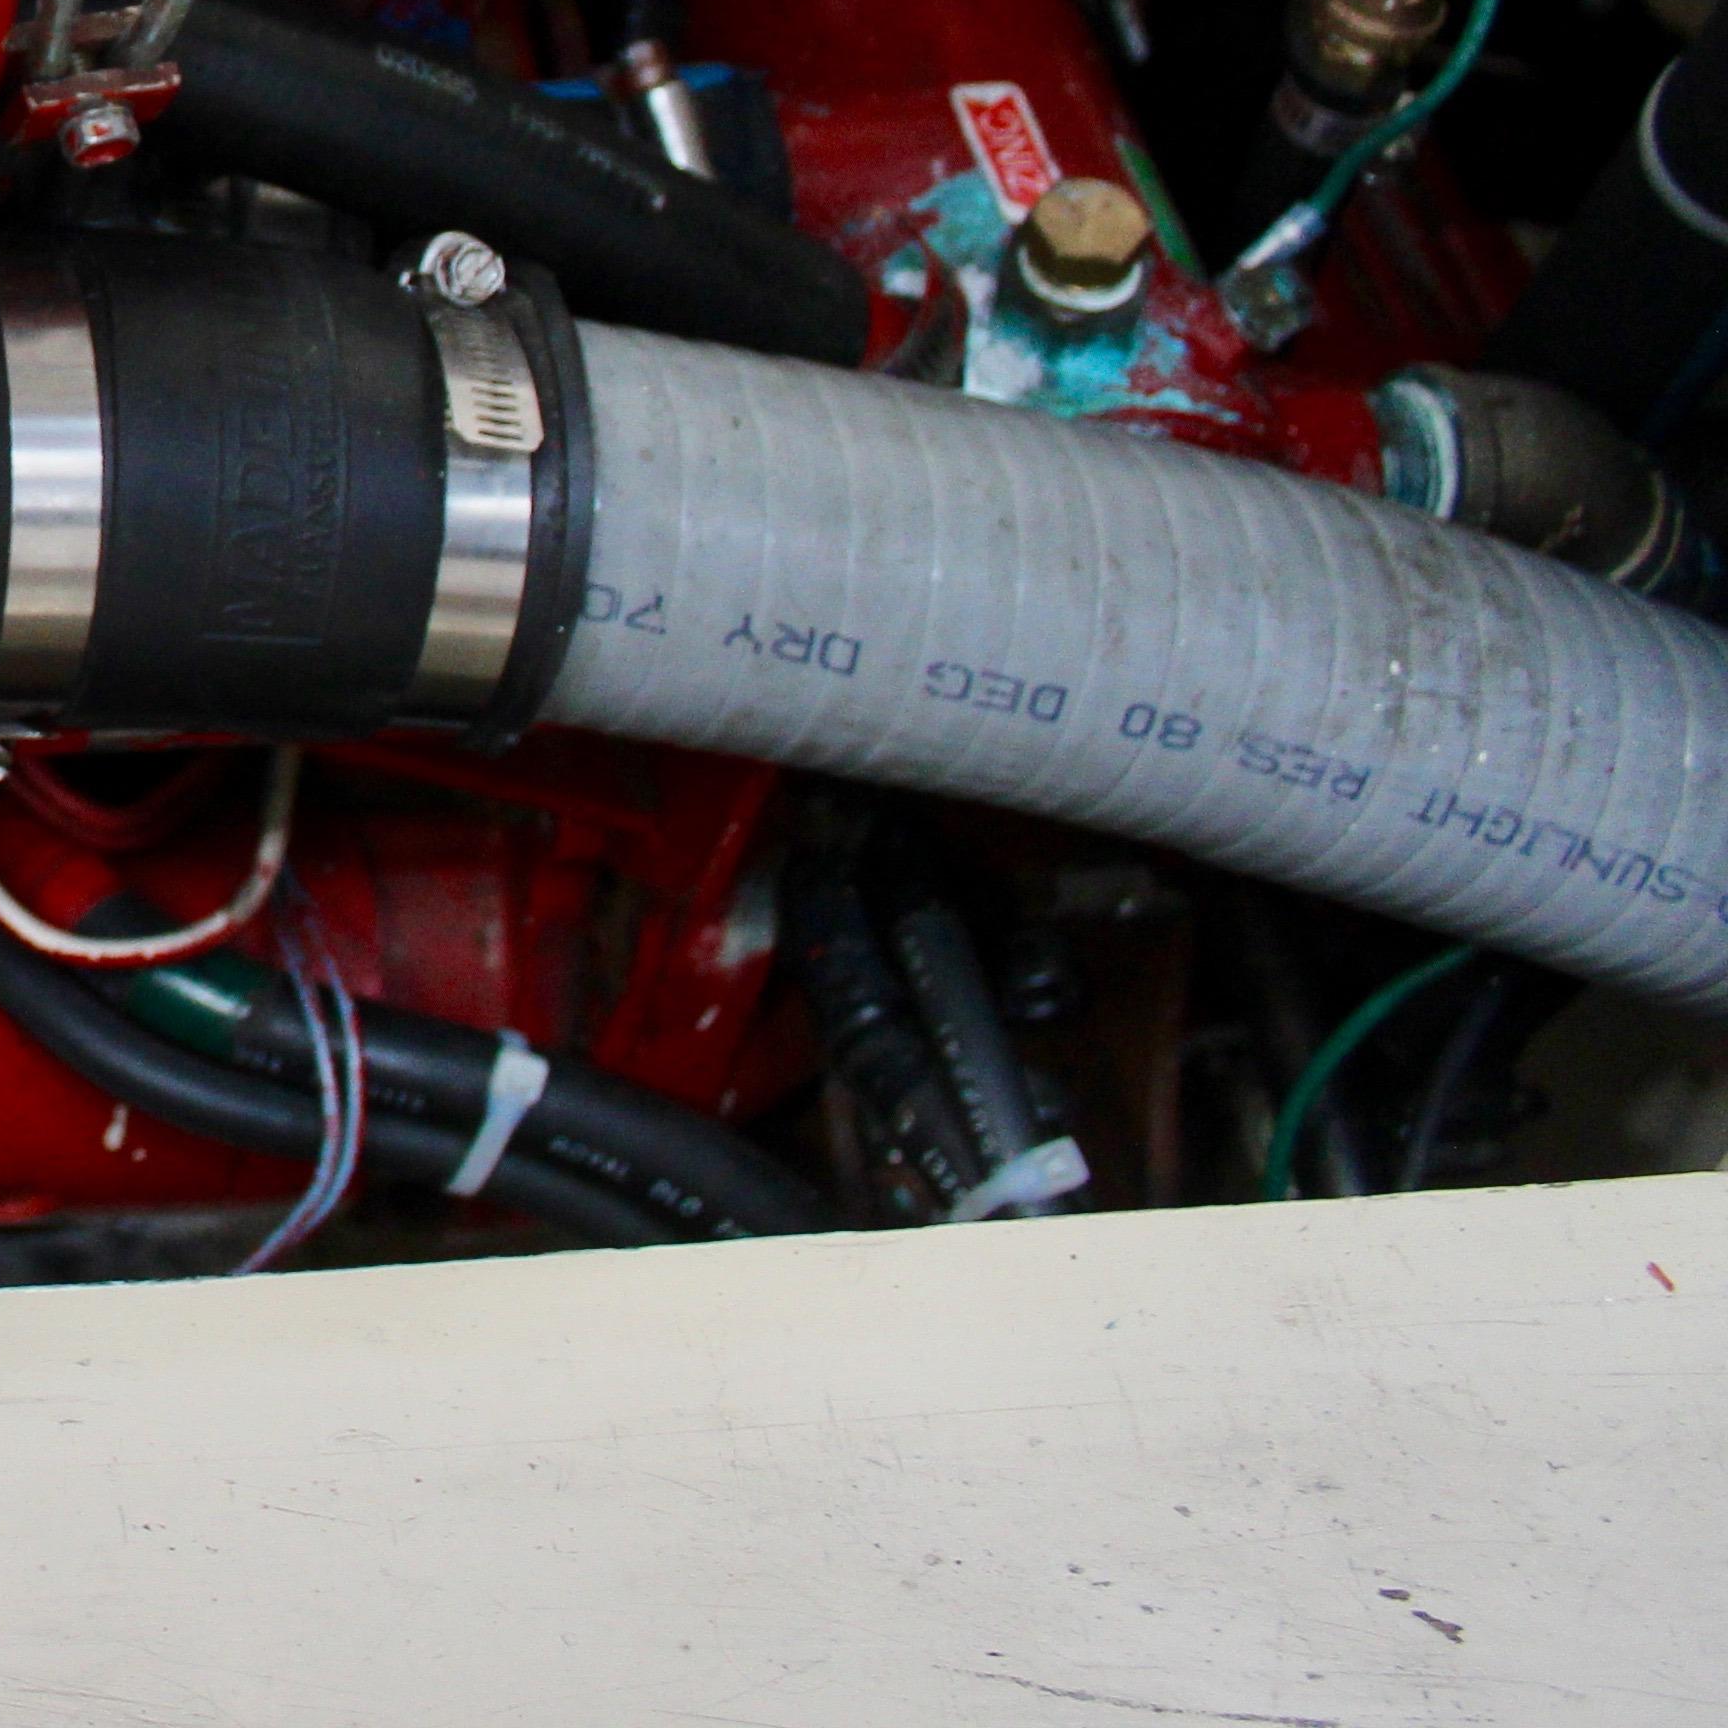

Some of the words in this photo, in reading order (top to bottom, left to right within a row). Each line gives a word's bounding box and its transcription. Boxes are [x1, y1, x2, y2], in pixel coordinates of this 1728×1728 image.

[723, 613, 864, 676] DRY
[925, 661, 1069, 723] DEG
[1119, 703, 1203, 751] 80
[1237, 735, 1372, 801] RES
[1408, 788, 1687, 904] SUNLIGHT
